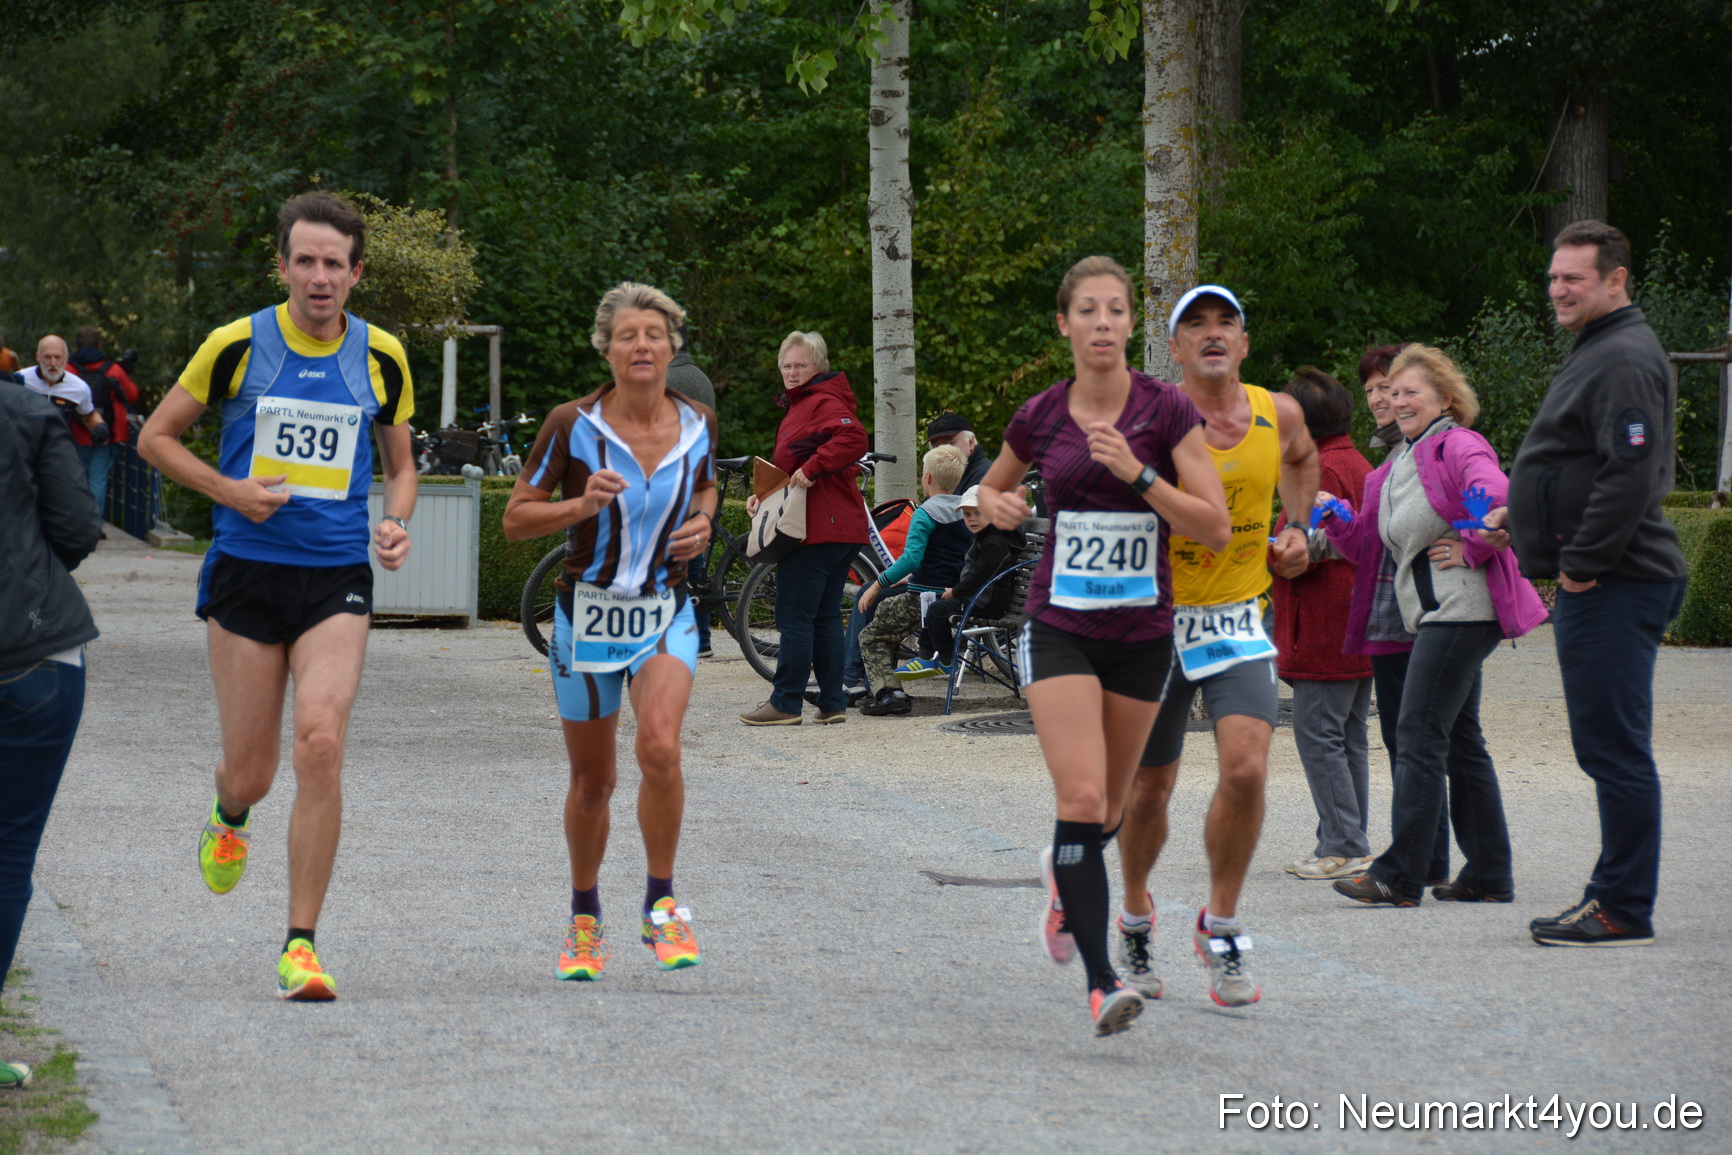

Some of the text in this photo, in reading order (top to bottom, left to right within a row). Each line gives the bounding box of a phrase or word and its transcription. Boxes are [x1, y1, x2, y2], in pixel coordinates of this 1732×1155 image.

[307, 370, 326, 378] asics
[260, 405, 344, 424] PARTL Neumarkt
[275, 422, 339, 462] 539
[1059, 521, 1142, 532] PARTL Neumarkt
[1066, 536, 1148, 571] 2240
[1085, 581, 1125, 595] Sarah
[577, 590, 610, 601] PARTL
[1173, 606, 1200, 614] ARTL
[585, 605, 662, 638] 2001
